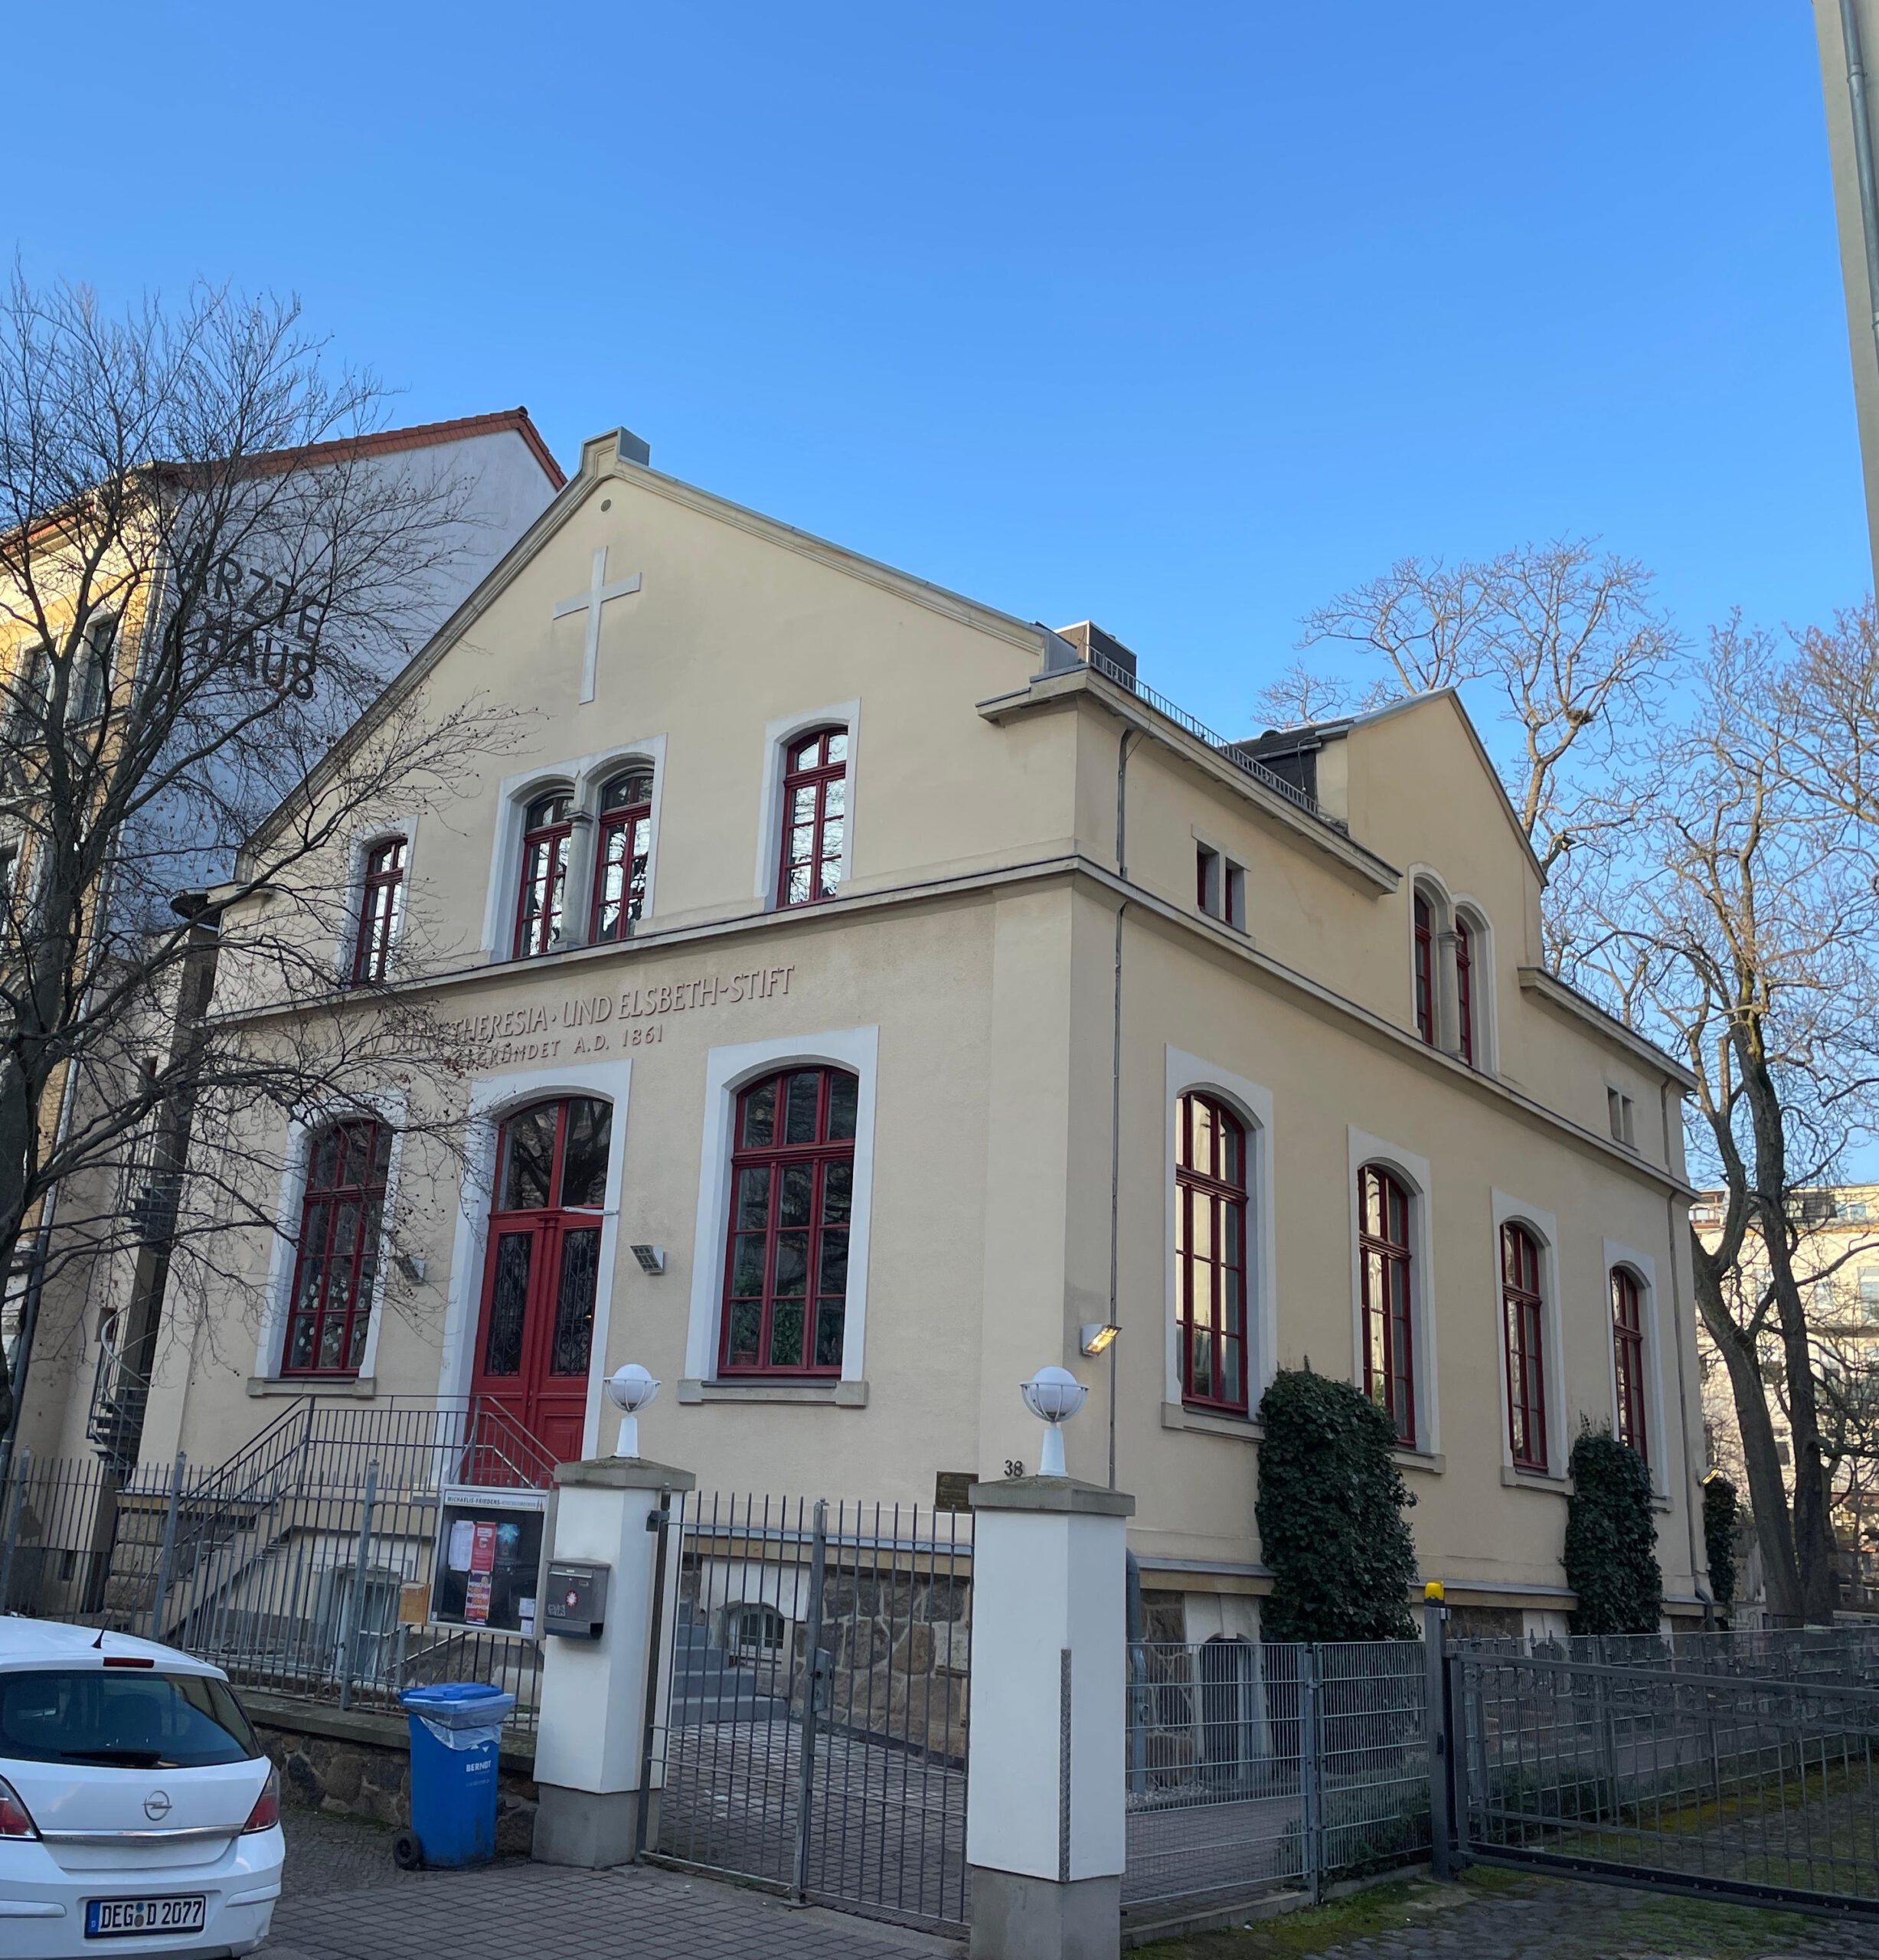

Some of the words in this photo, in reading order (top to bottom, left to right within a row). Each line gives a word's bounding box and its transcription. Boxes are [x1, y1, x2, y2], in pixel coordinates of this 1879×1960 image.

[563, 996, 613, 1027] UND
[618, 965, 795, 1019] ELSBETH-STIFT
[574, 1034, 609, 1054] A.D.
[623, 1024, 664, 1047] 1861
[1004, 1459, 1023, 1477] 38
[466, 1760, 492, 1772] BERNDT
[101, 1904, 134, 1929] DEG
[146, 1903, 157, 1926] D
[162, 1900, 202, 1925] 2077
